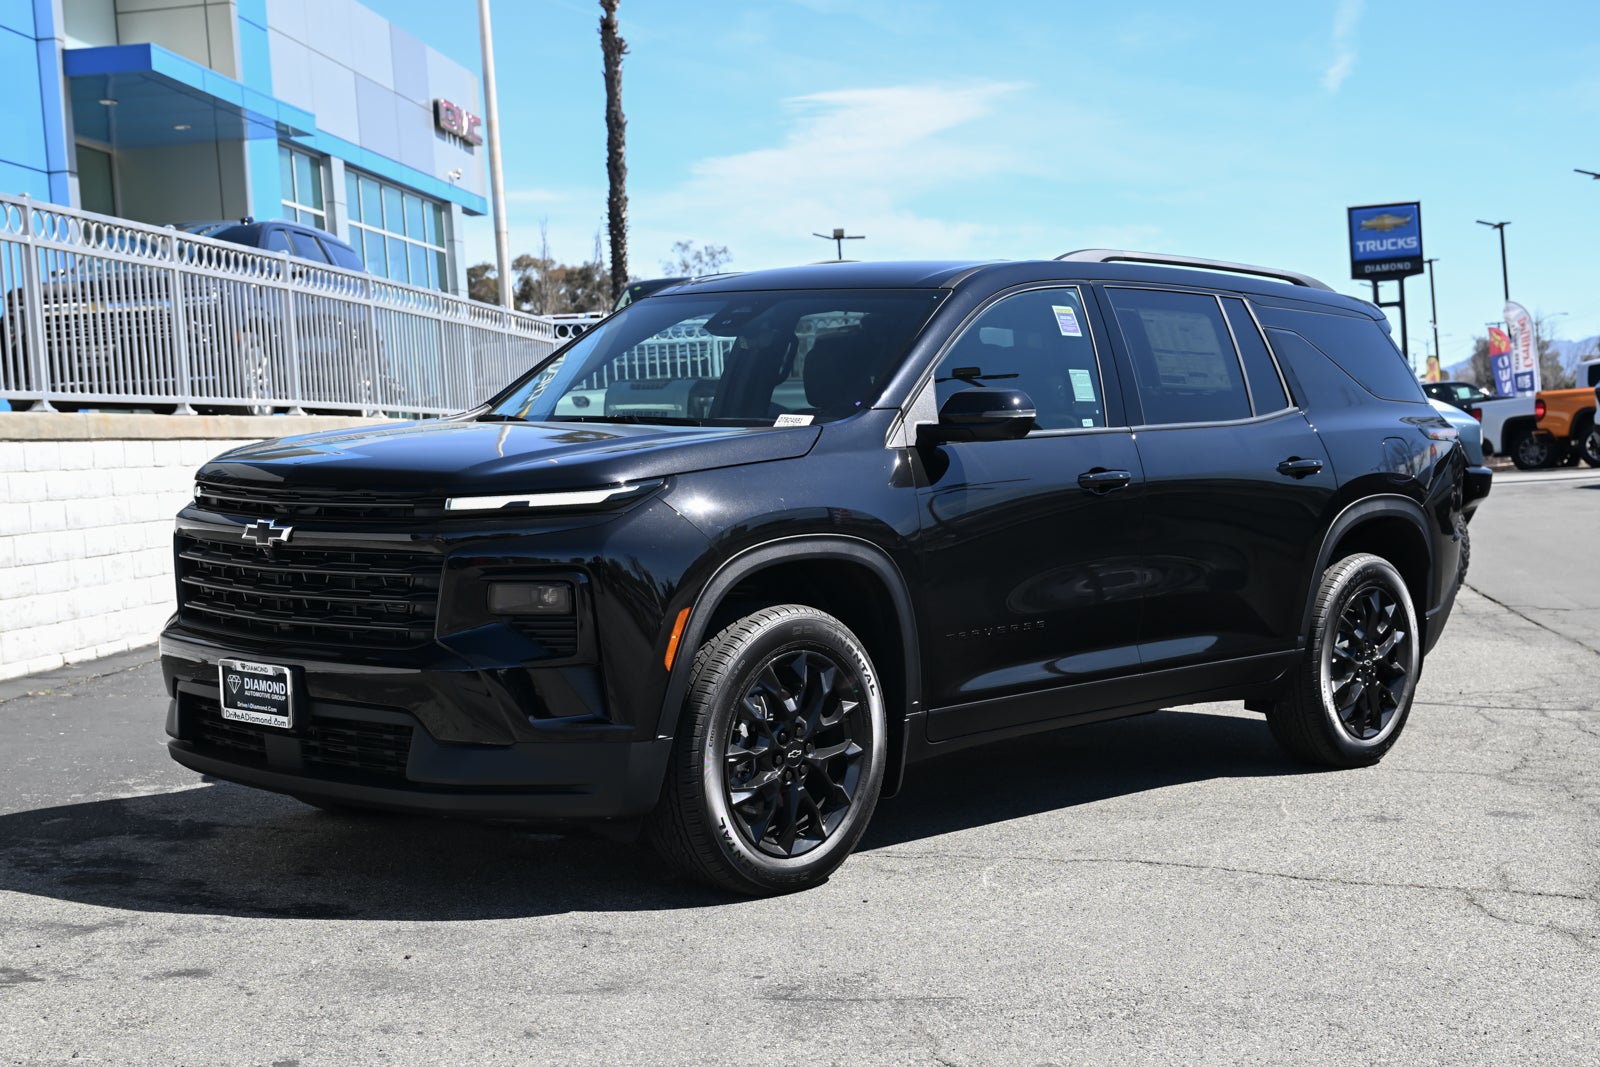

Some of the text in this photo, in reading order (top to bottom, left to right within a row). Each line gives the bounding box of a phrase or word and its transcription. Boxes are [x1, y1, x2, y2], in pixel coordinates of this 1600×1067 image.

[1356, 236, 1418, 253] TRUCKS
[1364, 262, 1411, 273] DIAMOND
[244, 677, 286, 695] DIAMOND
[244, 690, 271, 699] AUTOMOTIVE
